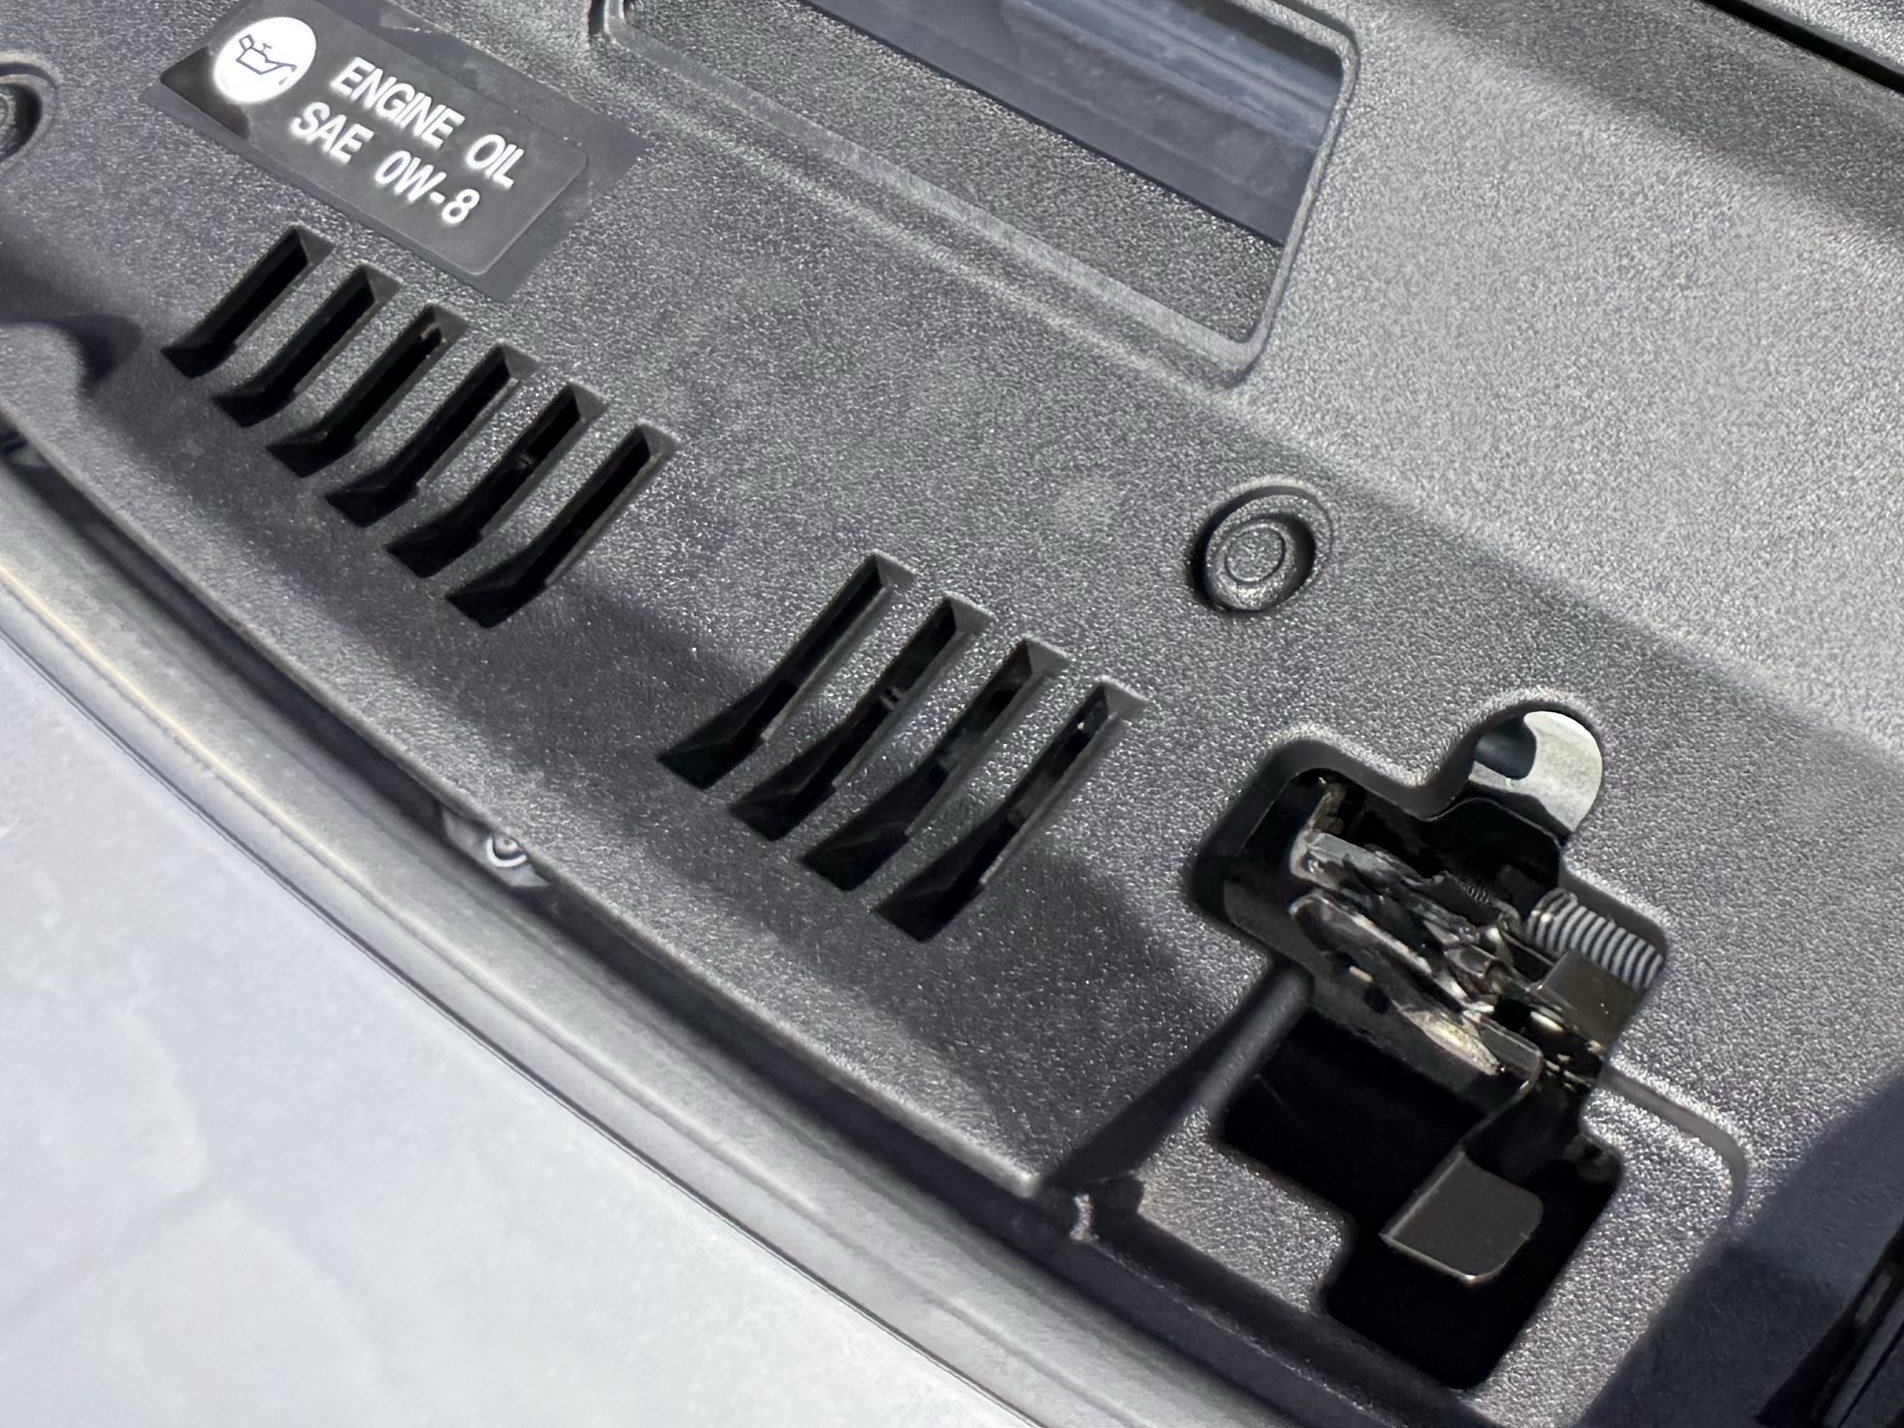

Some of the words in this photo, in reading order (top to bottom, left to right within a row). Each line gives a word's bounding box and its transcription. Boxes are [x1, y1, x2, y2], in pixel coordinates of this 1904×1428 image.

[289, 101, 376, 166] SAE
[372, 150, 481, 226] 0W-8
[332, 55, 466, 150] ENGINE
[462, 133, 525, 190] OIL
